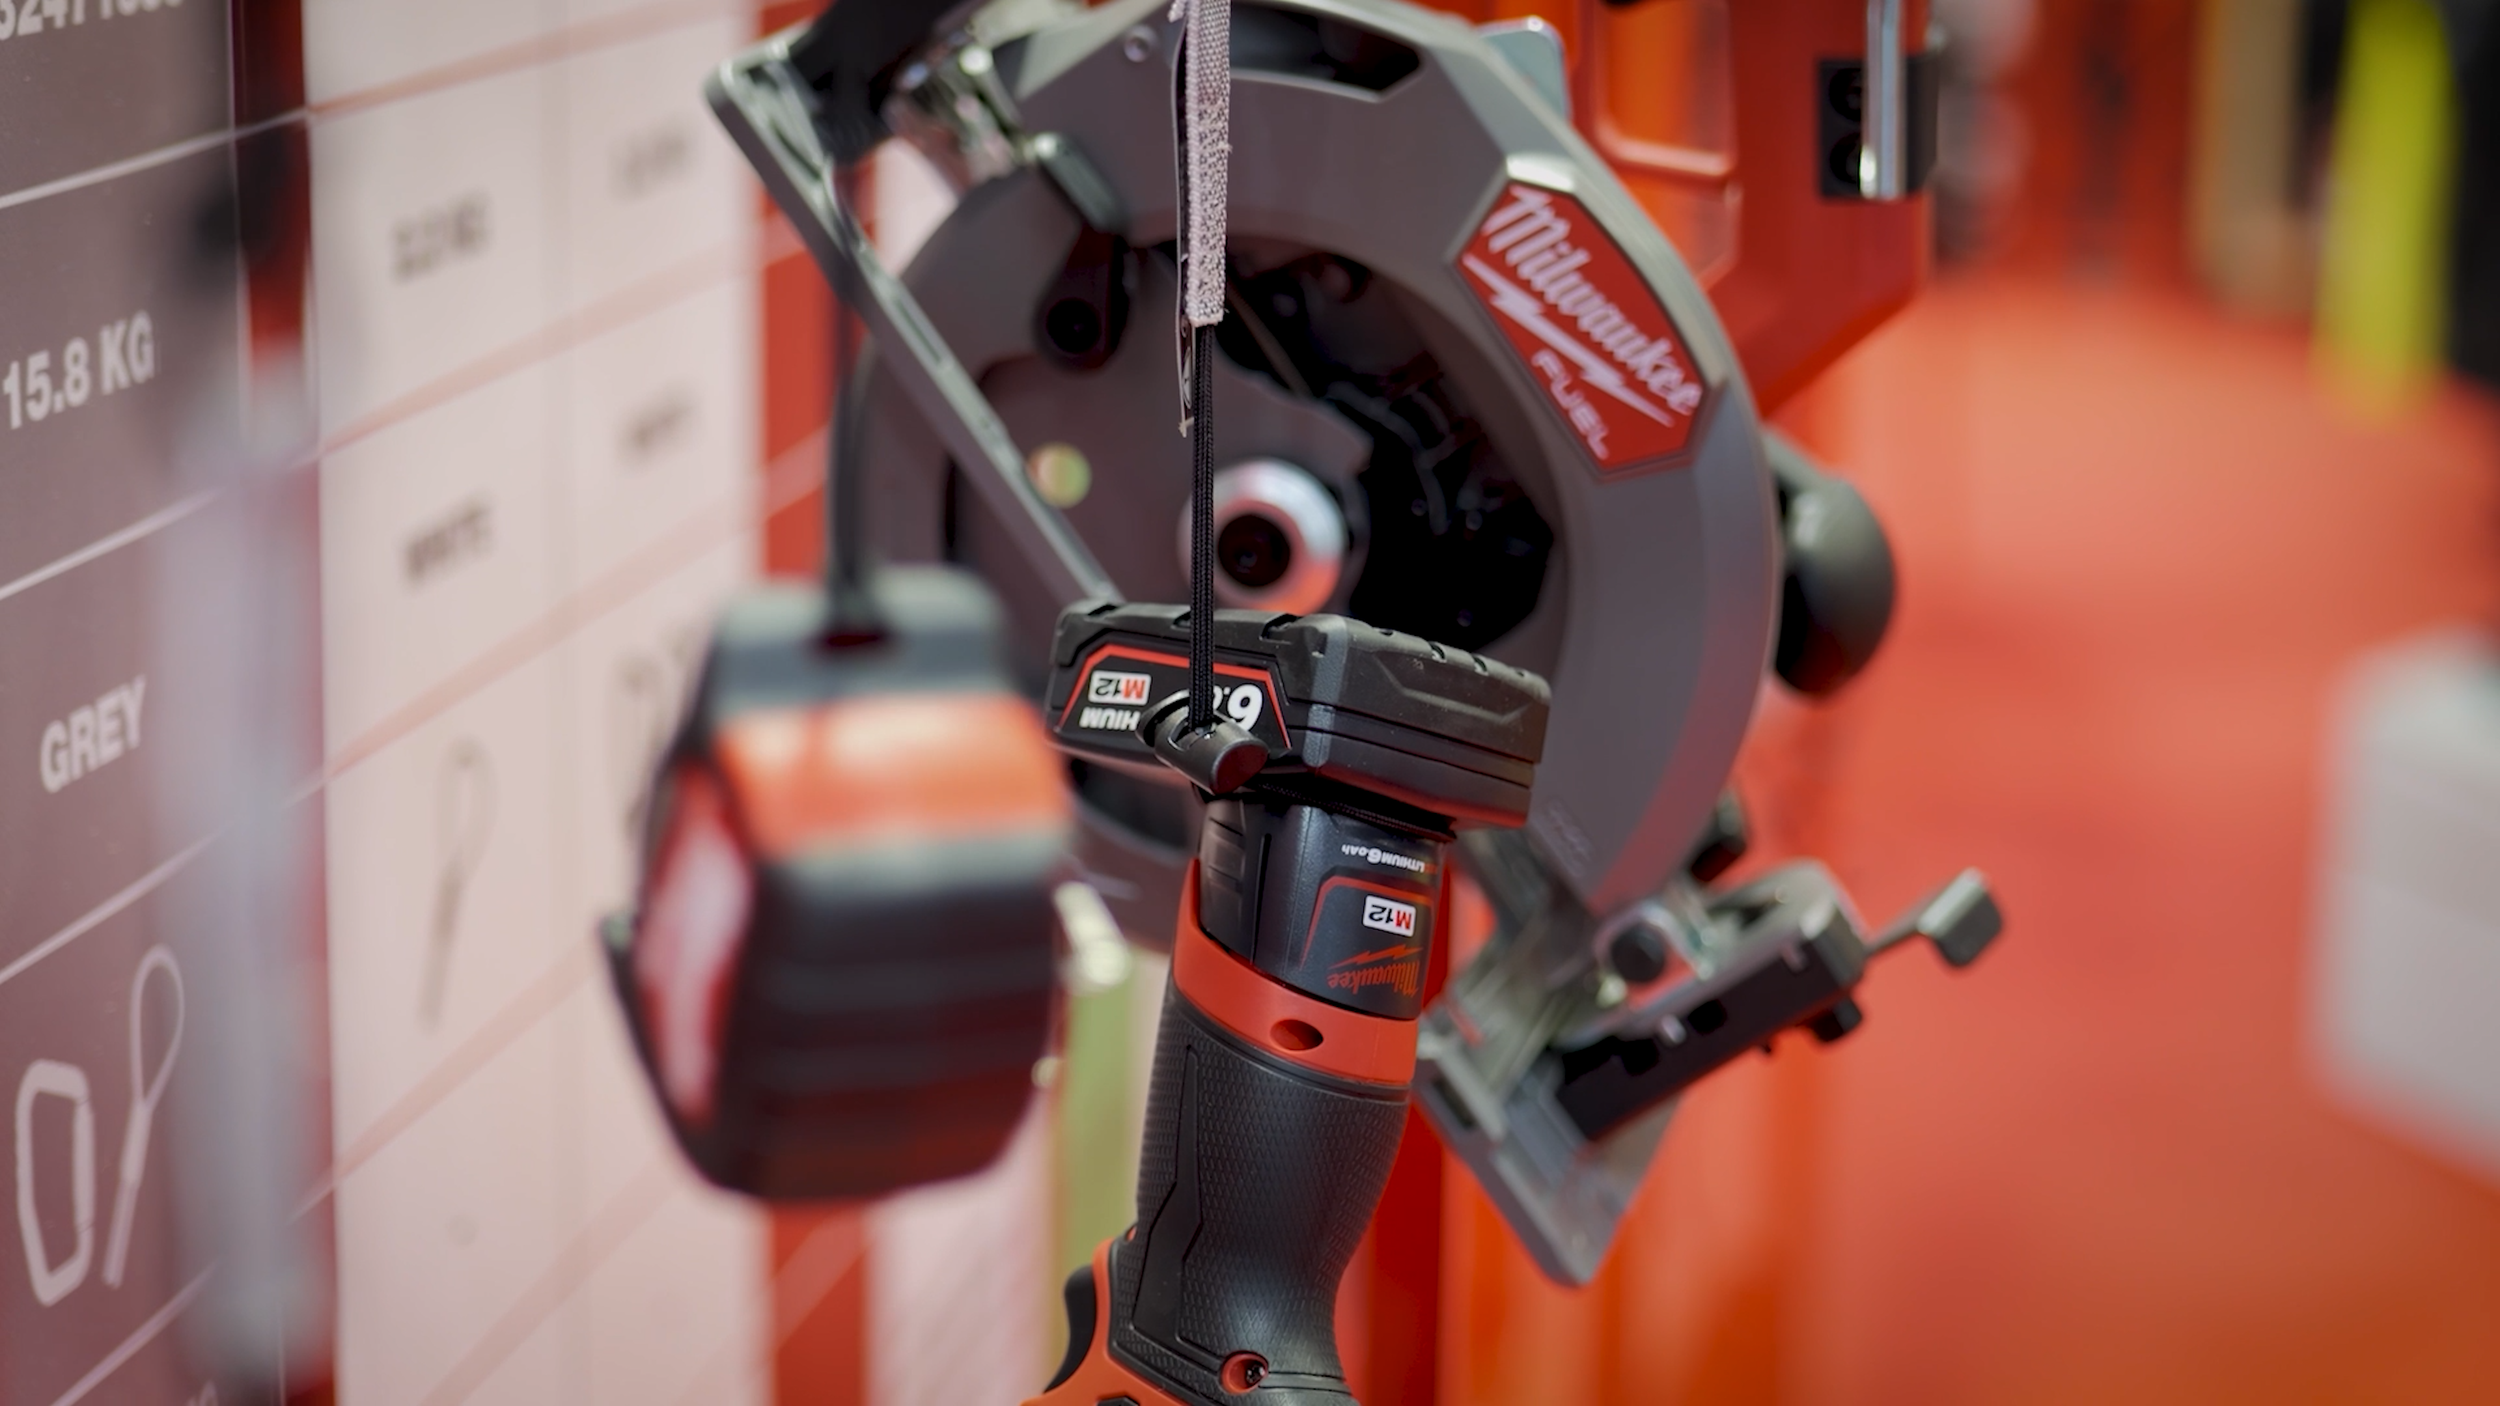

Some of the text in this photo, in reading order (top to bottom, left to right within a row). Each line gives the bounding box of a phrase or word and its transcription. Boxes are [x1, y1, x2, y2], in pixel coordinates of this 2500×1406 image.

[1480, 183, 1702, 416] Milwaukee
[3, 310, 155, 430] 15.8 KG
[1531, 348, 1609, 460] FUEL
[1095, 677, 1146, 699] M12
[1213, 684, 1263, 731] 6.
[40, 674, 146, 794] GREY
[1079, 707, 1141, 731] HIUM
[1368, 904, 1412, 930] M12
[1327, 959, 1421, 997] Milwaukee
